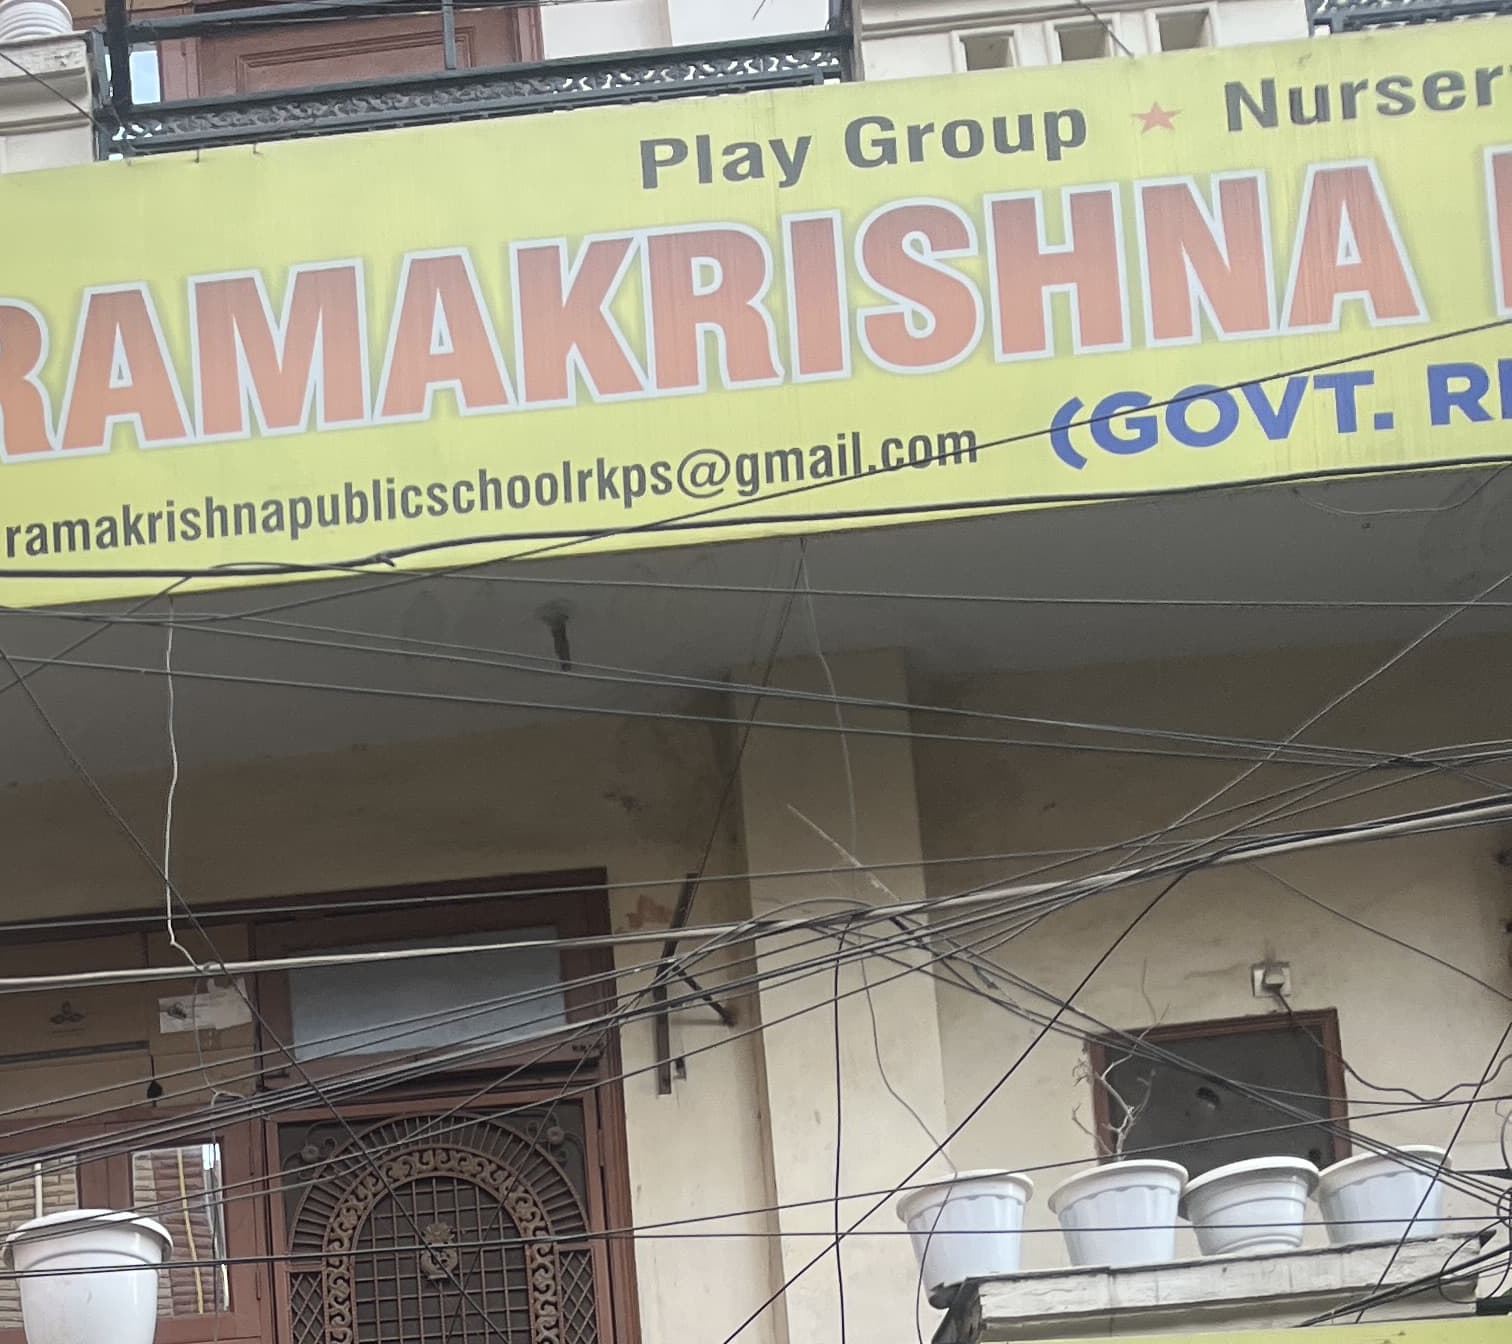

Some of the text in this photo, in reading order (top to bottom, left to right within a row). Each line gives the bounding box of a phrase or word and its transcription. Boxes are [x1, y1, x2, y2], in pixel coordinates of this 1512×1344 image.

[640, 65, 1512, 190] Play Group Nurser
[1050, 370, 1394, 470] (GOVT.
[5, 429, 979, 561] ramakrishnapublicschoolrkps@gmail.com
